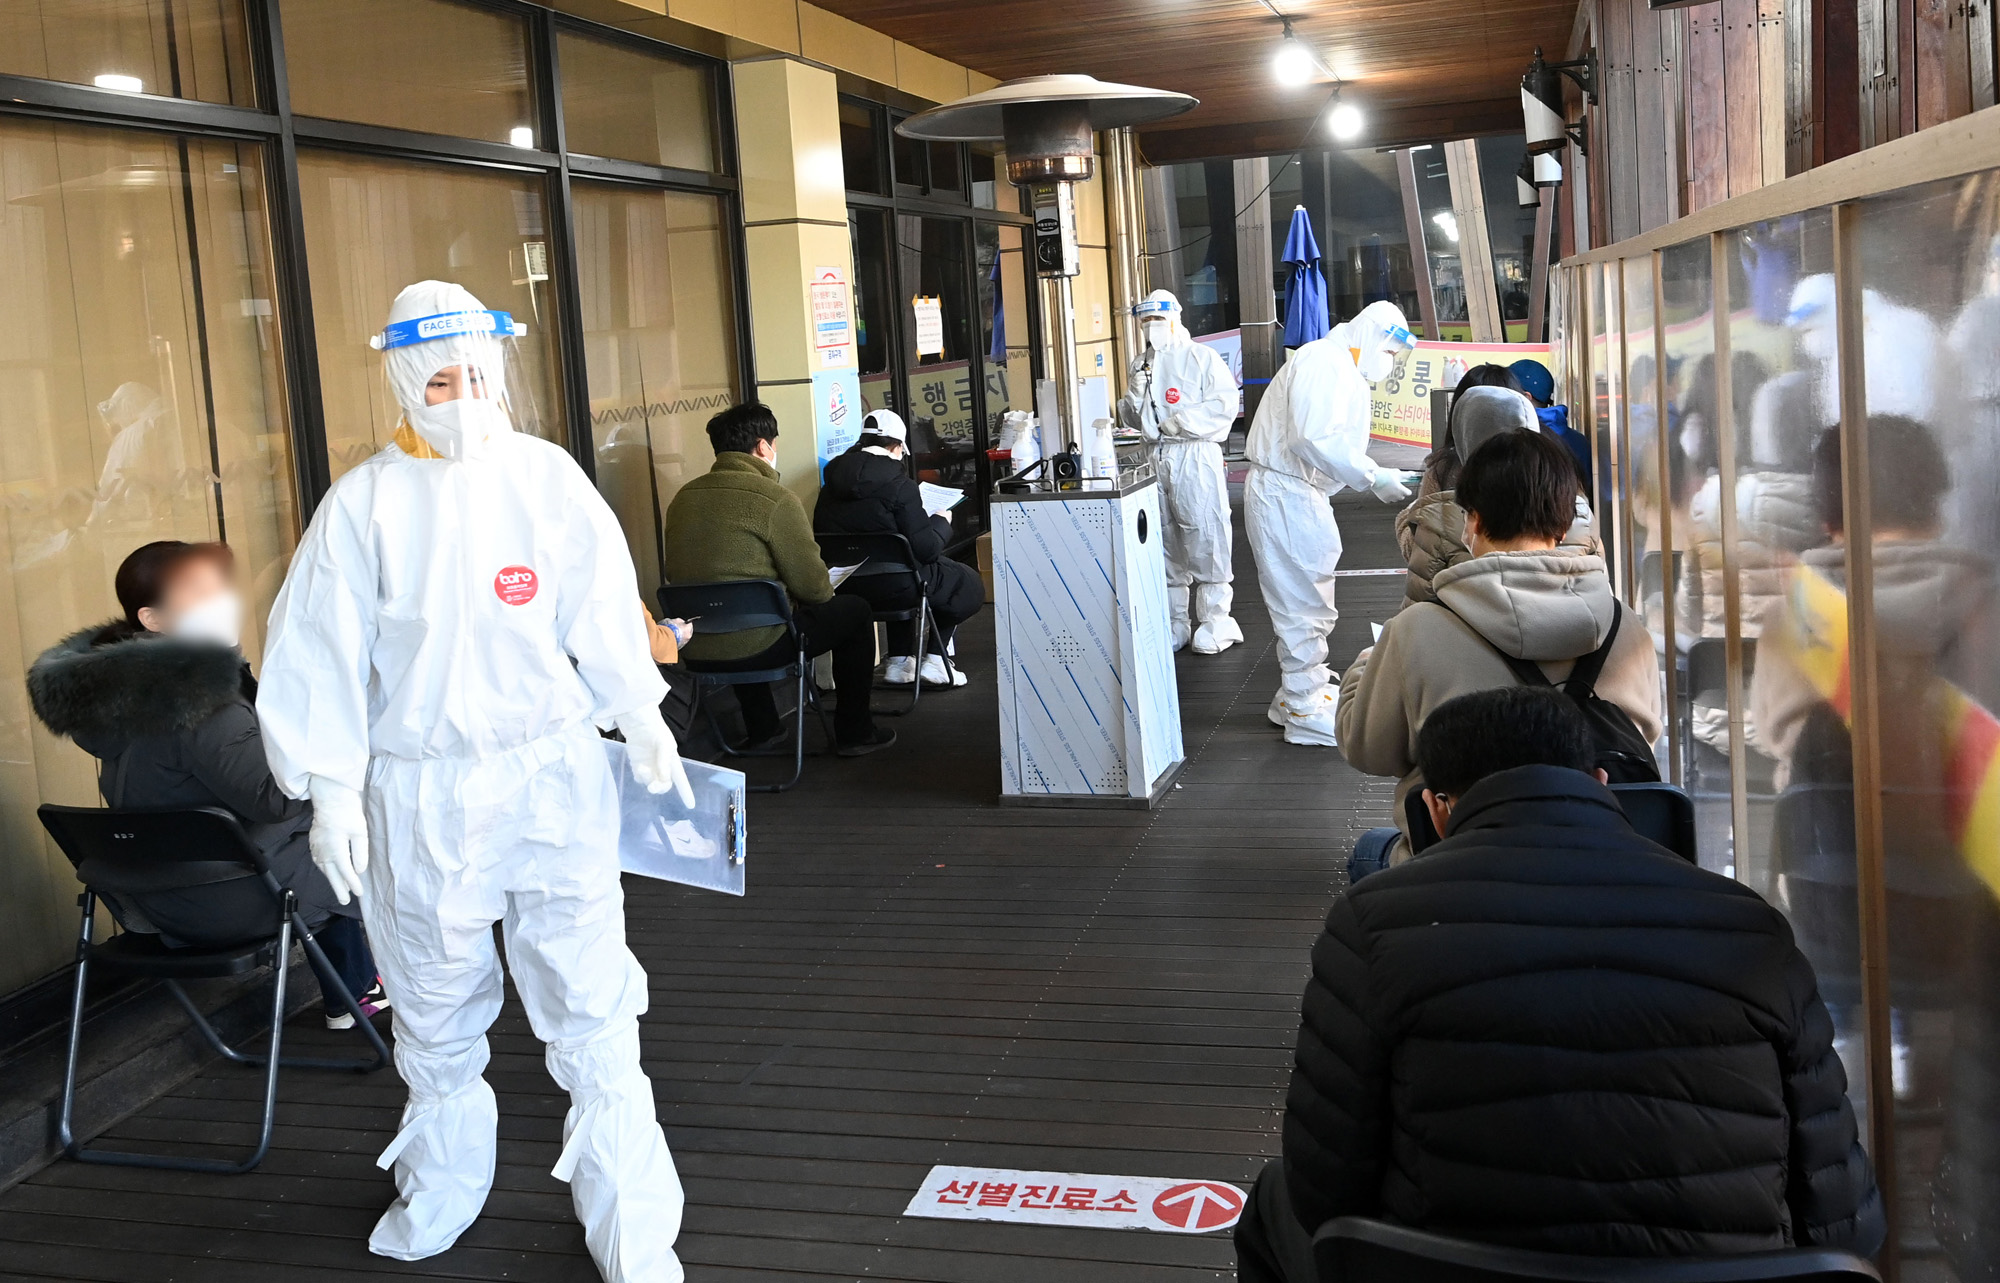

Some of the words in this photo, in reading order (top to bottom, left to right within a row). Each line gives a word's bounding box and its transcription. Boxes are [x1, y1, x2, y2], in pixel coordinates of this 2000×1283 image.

[424, 319, 453, 332] FACE
[1025, 516, 1037, 532] STEEL
[1069, 514, 1082, 531] STEEL
[1040, 622, 1052, 637] STEEL
[1084, 621, 1097, 637] STEEL
[1054, 727, 1067, 742] STEEL
[1099, 727, 1111, 742] STEEL
[936, 1180, 1138, 1213] 선별진료소
